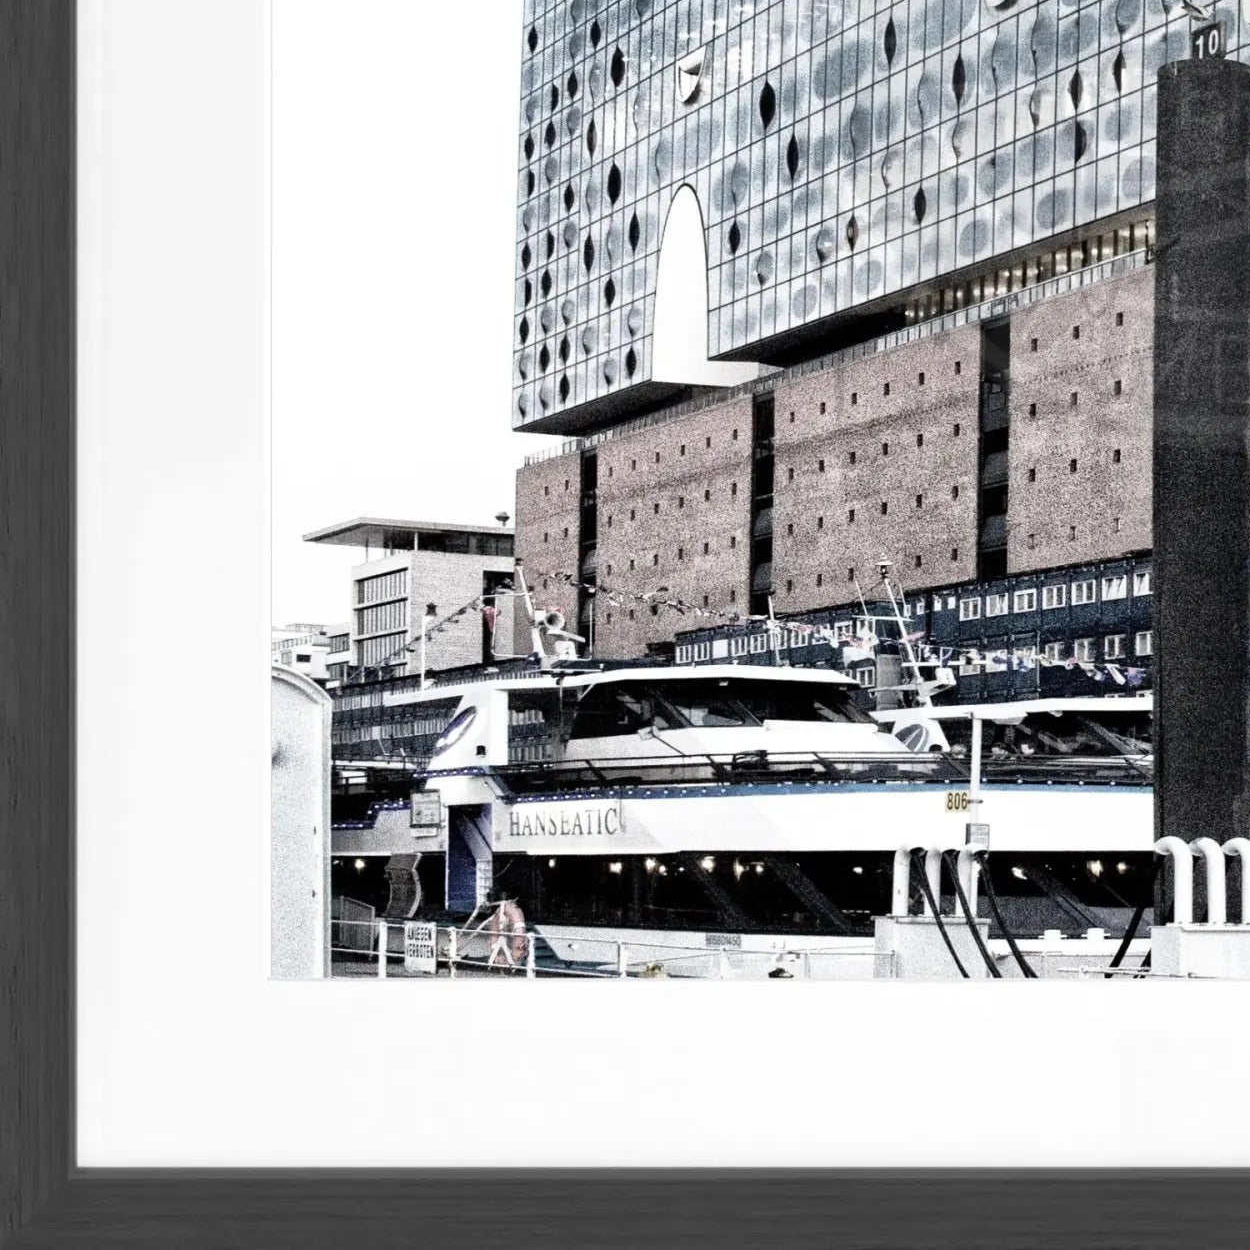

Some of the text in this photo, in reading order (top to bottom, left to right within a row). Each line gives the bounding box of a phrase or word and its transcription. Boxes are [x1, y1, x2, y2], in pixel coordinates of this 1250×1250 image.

[1195, 29, 1220, 59] 10
[947, 792, 968, 810] 806
[509, 808, 617, 836] HANSEATIC
